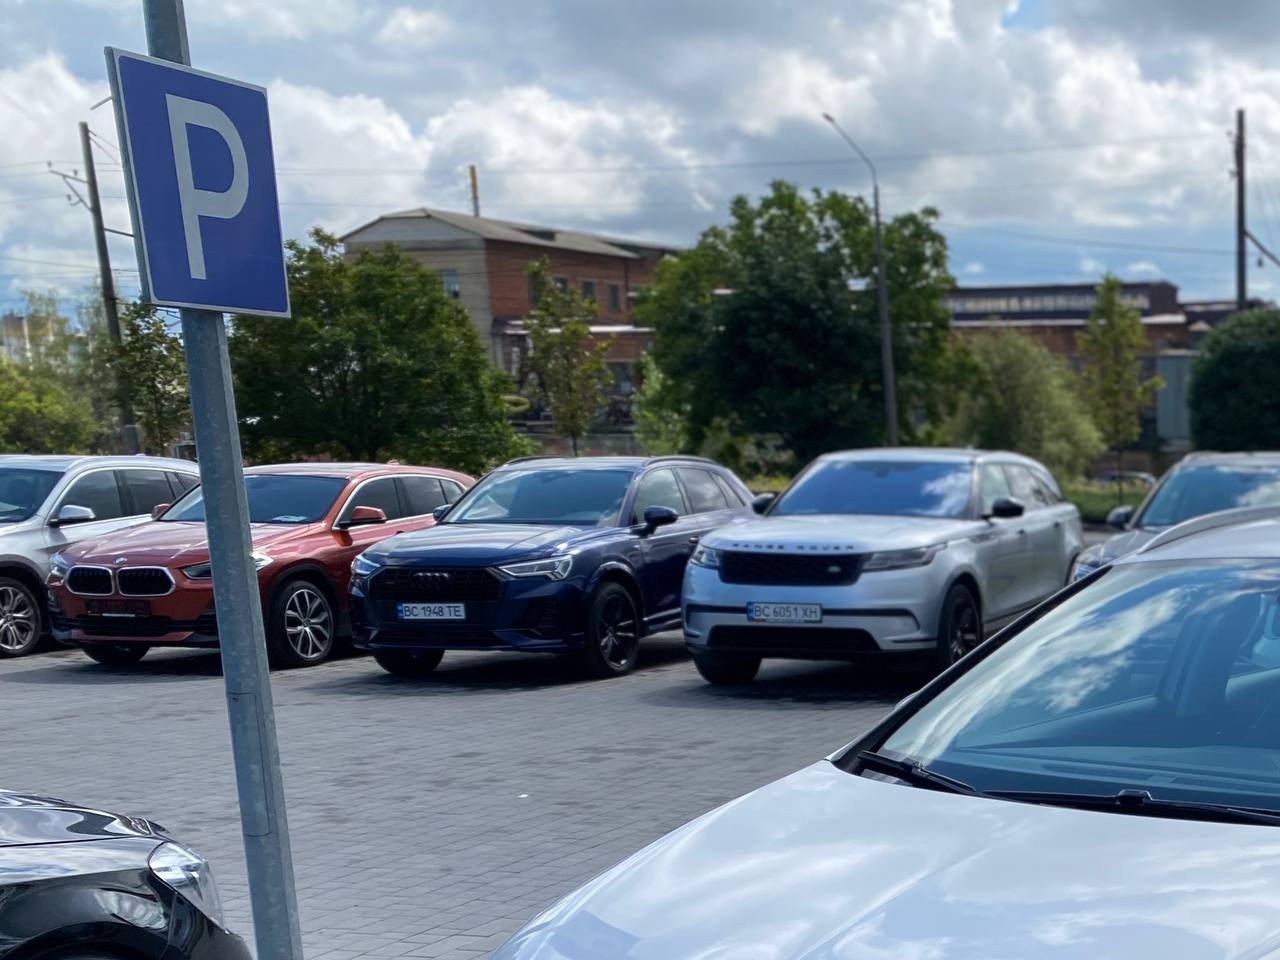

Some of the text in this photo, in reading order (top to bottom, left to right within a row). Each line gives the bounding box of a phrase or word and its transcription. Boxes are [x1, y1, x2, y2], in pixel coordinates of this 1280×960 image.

[165, 93, 249, 280] P
[403, 605, 462, 617] BC 1948 TE
[772, 605, 798, 618] 6051
